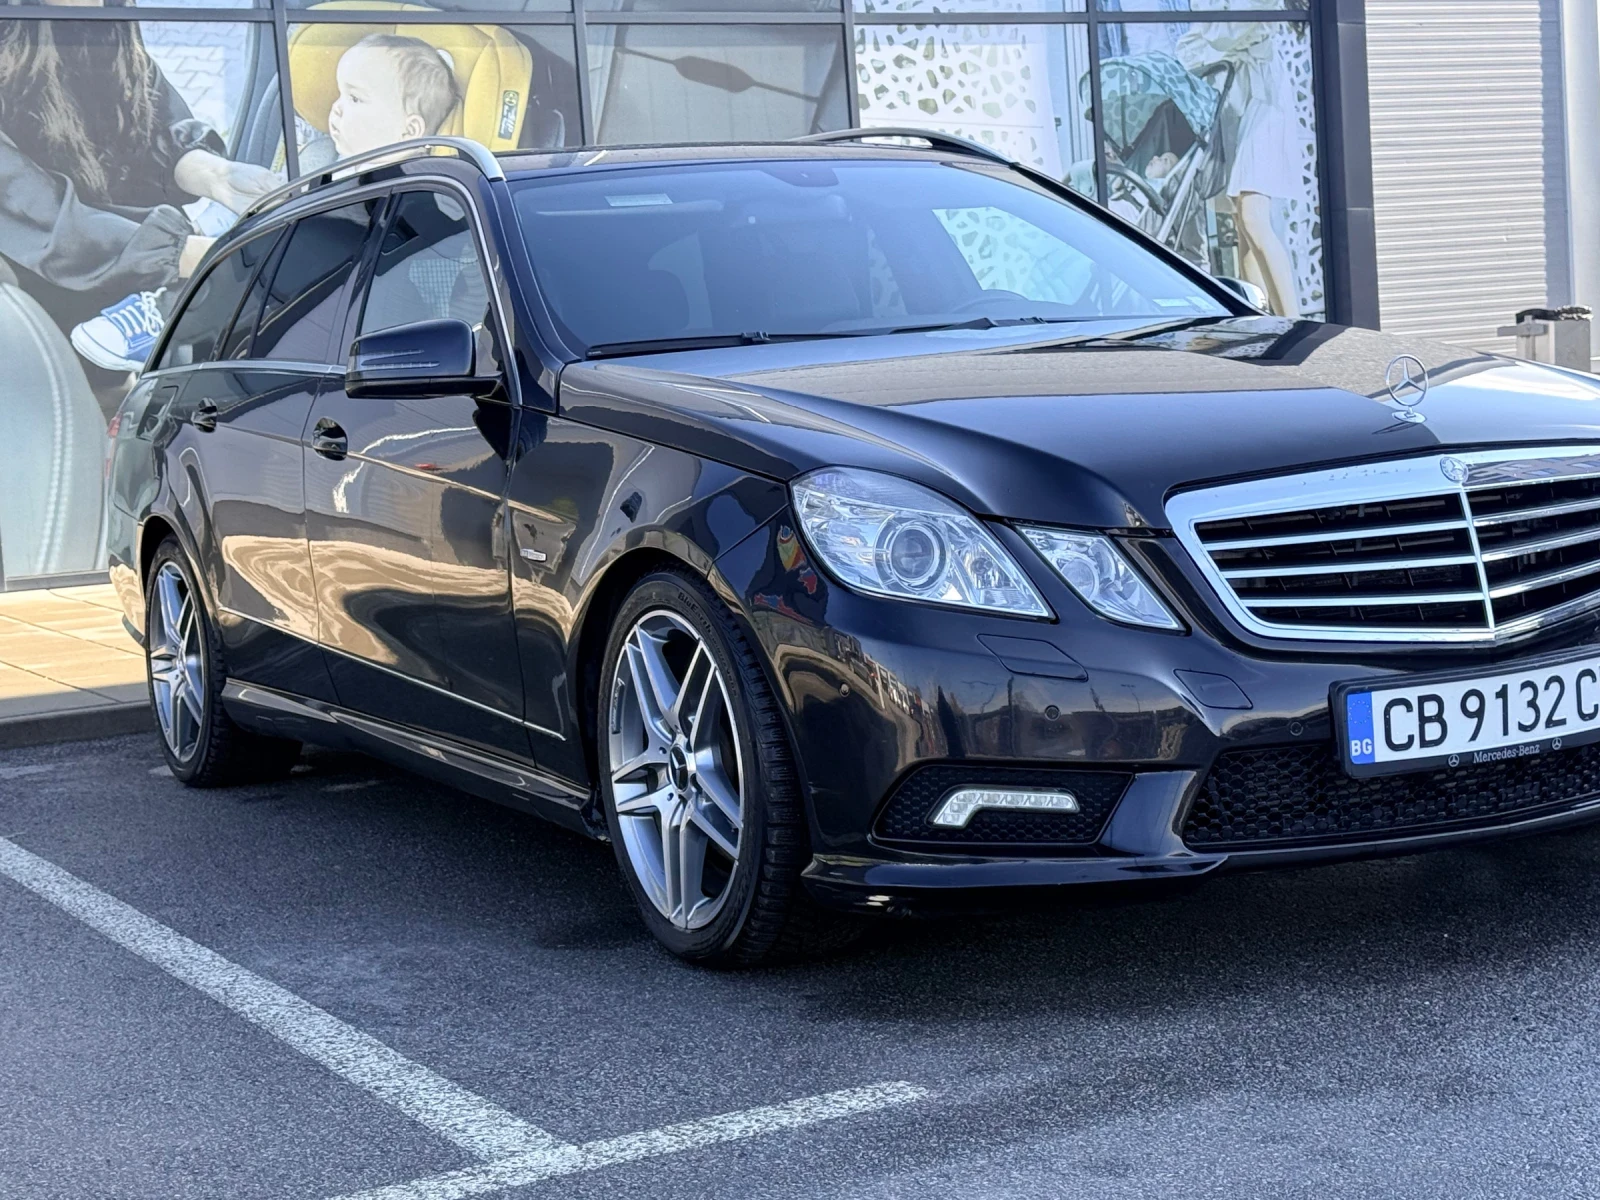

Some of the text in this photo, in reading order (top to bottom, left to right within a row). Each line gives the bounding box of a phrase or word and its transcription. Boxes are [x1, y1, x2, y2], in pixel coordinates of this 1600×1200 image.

[1383, 693, 1448, 752] CB
[1460, 674, 1567, 742] 9132
[1351, 738, 1373, 756] BG
[1473, 744, 1540, 764] Mercedes-Benz
